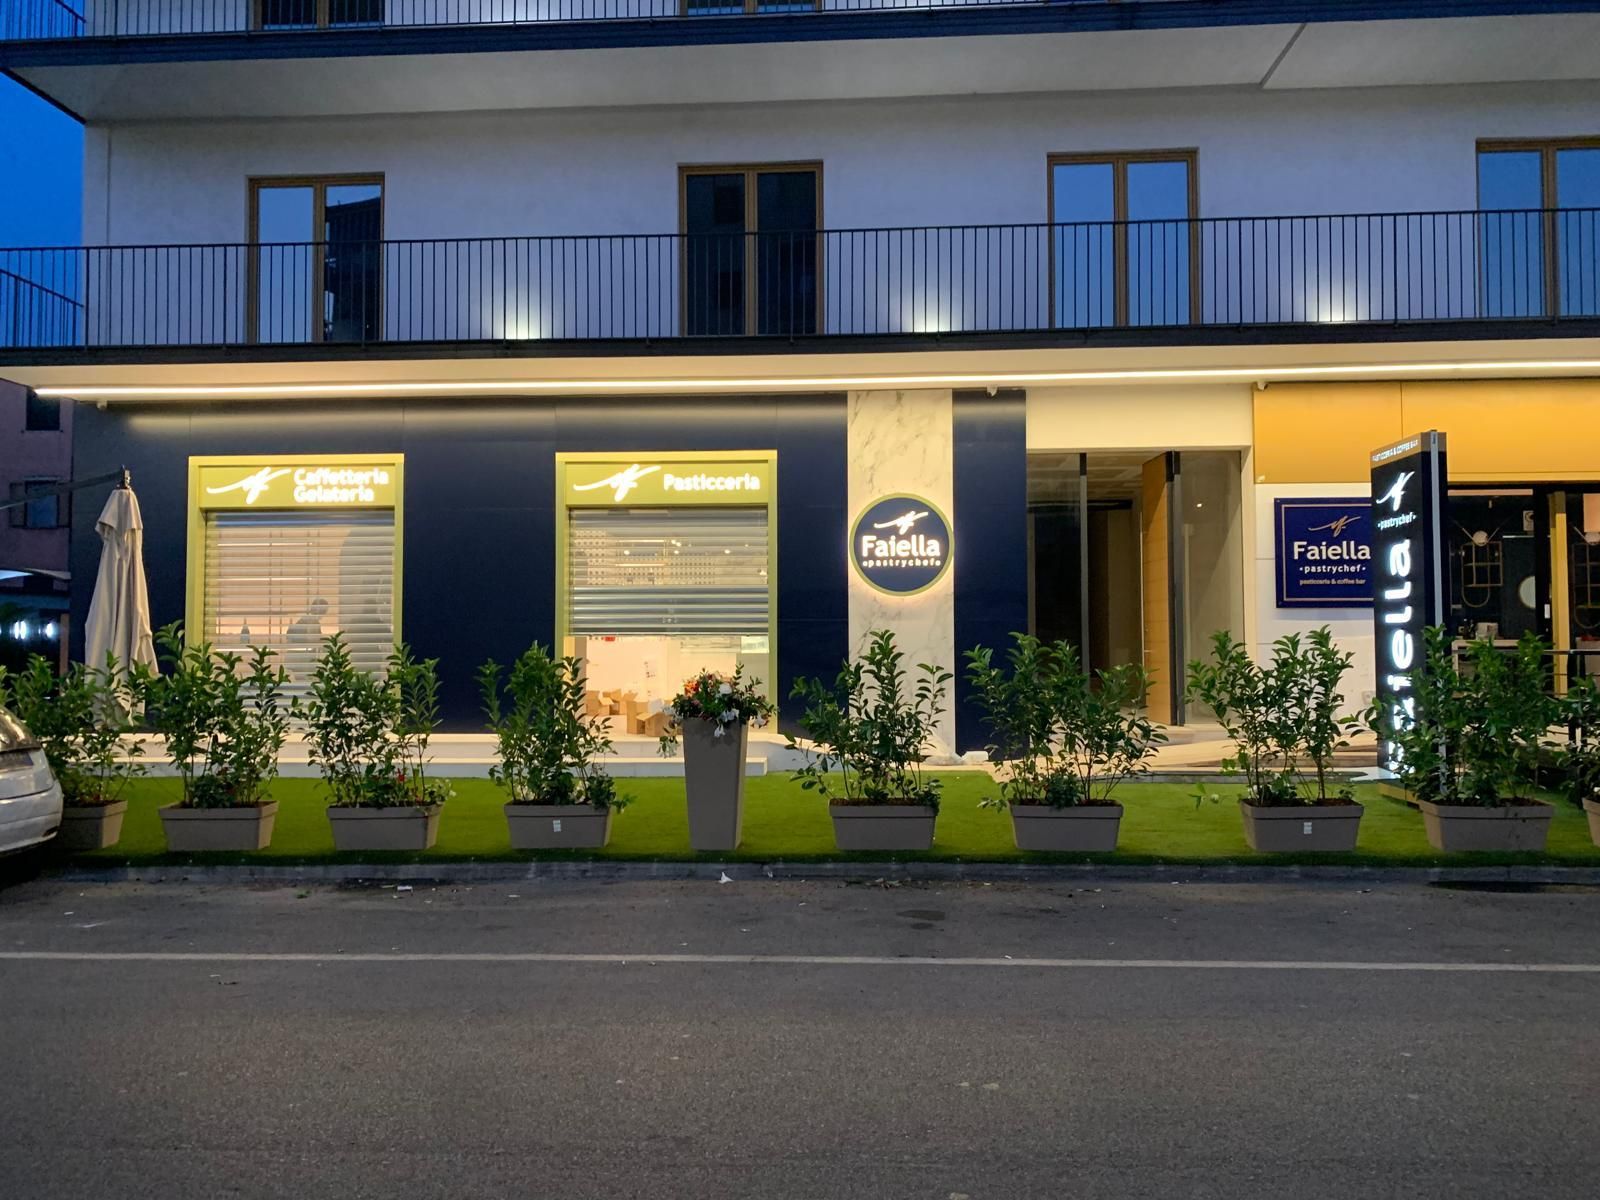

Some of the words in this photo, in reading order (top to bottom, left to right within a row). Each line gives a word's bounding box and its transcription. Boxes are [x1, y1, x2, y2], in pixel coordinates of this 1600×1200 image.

[294, 468, 389, 485] Caffetteria
[663, 473, 761, 491] Pasticceria
[294, 485, 374, 503] Gelateria
[862, 534, 941, 557] Faiella
[1293, 541, 1371, 560] Faiella
